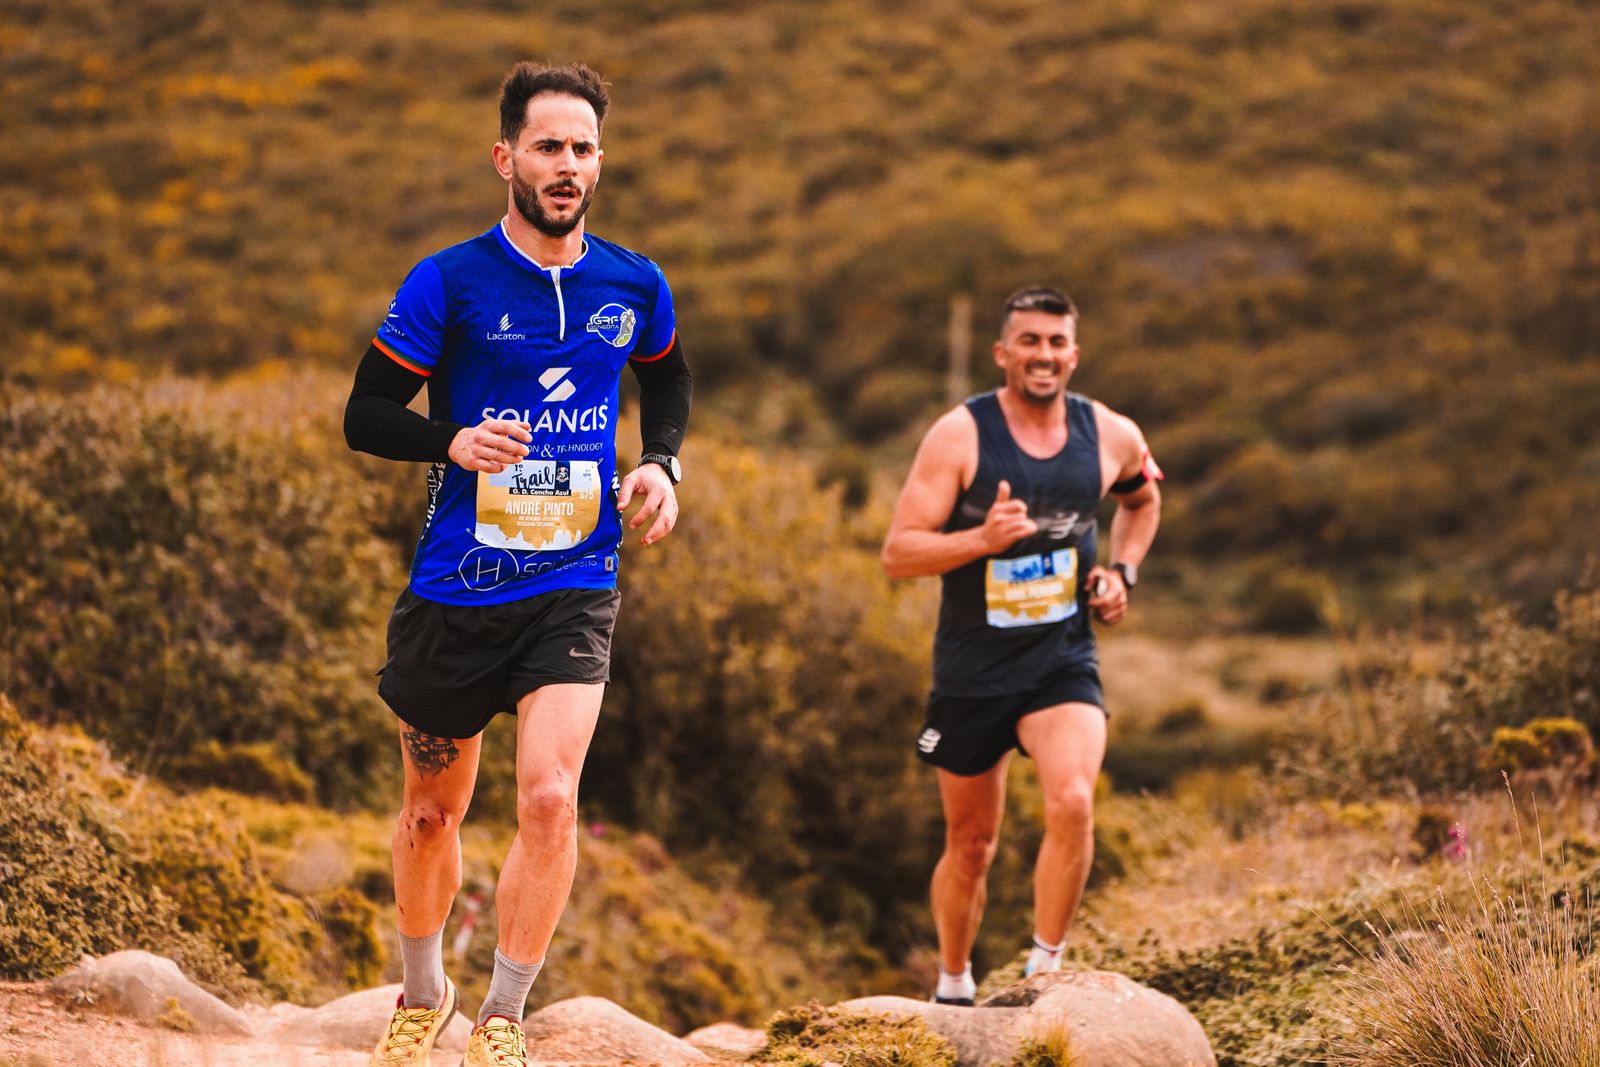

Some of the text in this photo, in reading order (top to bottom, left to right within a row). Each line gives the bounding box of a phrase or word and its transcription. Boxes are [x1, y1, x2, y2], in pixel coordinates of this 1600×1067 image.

[593, 316, 619, 325] GRF
[486, 331, 526, 341] Lacatoni
[540, 443, 555, 458] &
[556, 441, 604, 454] TEHNOLOGY
[511, 466, 555, 490] Trail
[530, 489, 554, 497] Concha
[554, 489, 570, 497] Azul
[579, 489, 594, 500] 675
[543, 502, 574, 517] PINTO
